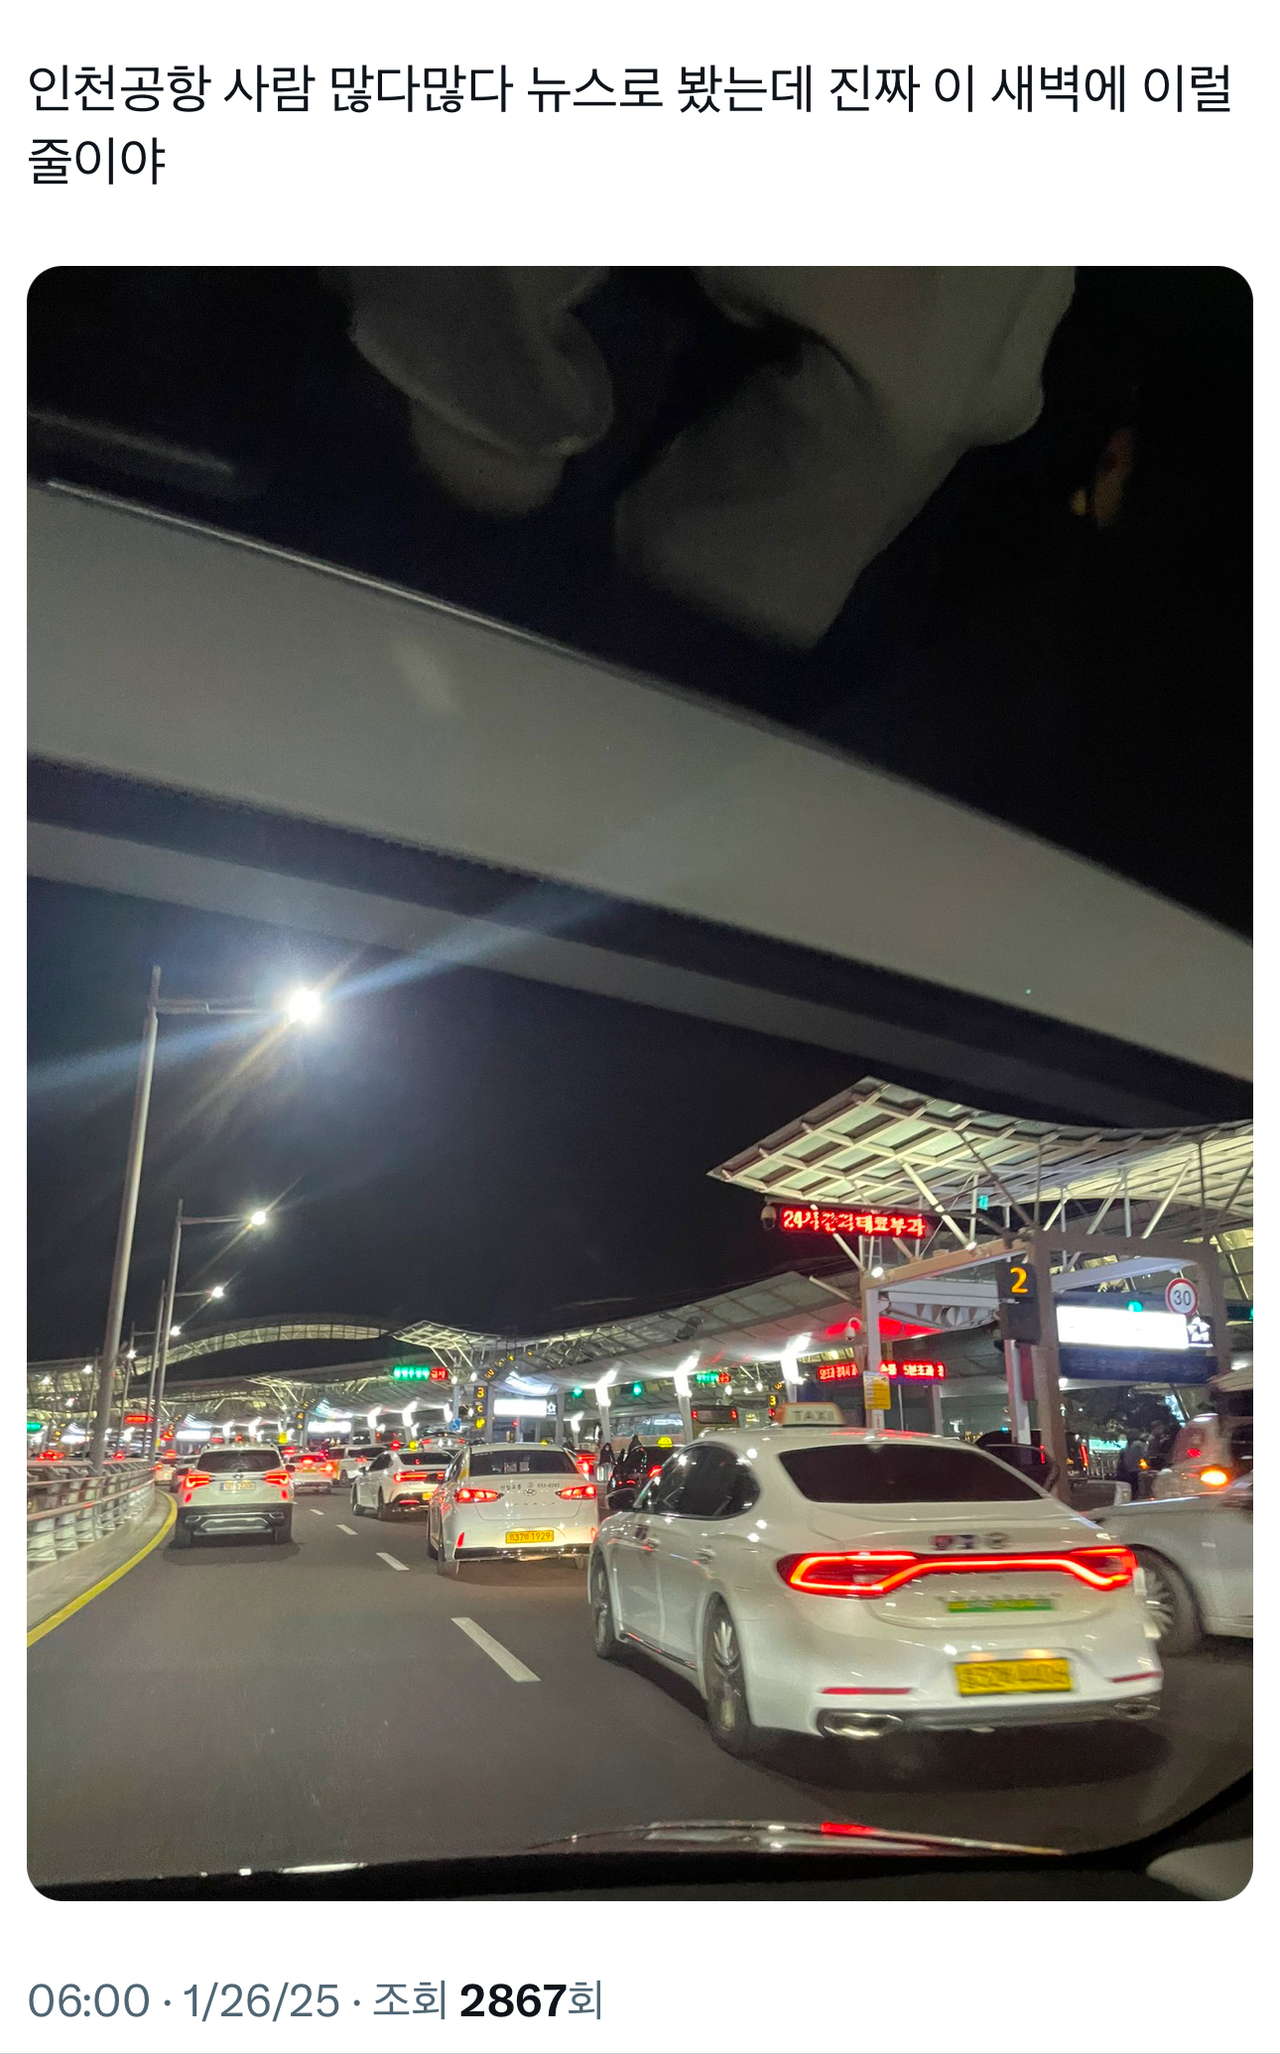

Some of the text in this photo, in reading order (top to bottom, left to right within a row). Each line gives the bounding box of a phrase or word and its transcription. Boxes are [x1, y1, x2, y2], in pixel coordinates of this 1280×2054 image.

[1010, 1267, 1029, 1294] 2
[1173, 1290, 1192, 1306] 30
[477, 1387, 484, 1398] 3
[769, 1395, 777, 1407] 3
[793, 1410, 835, 1422] TAXI
